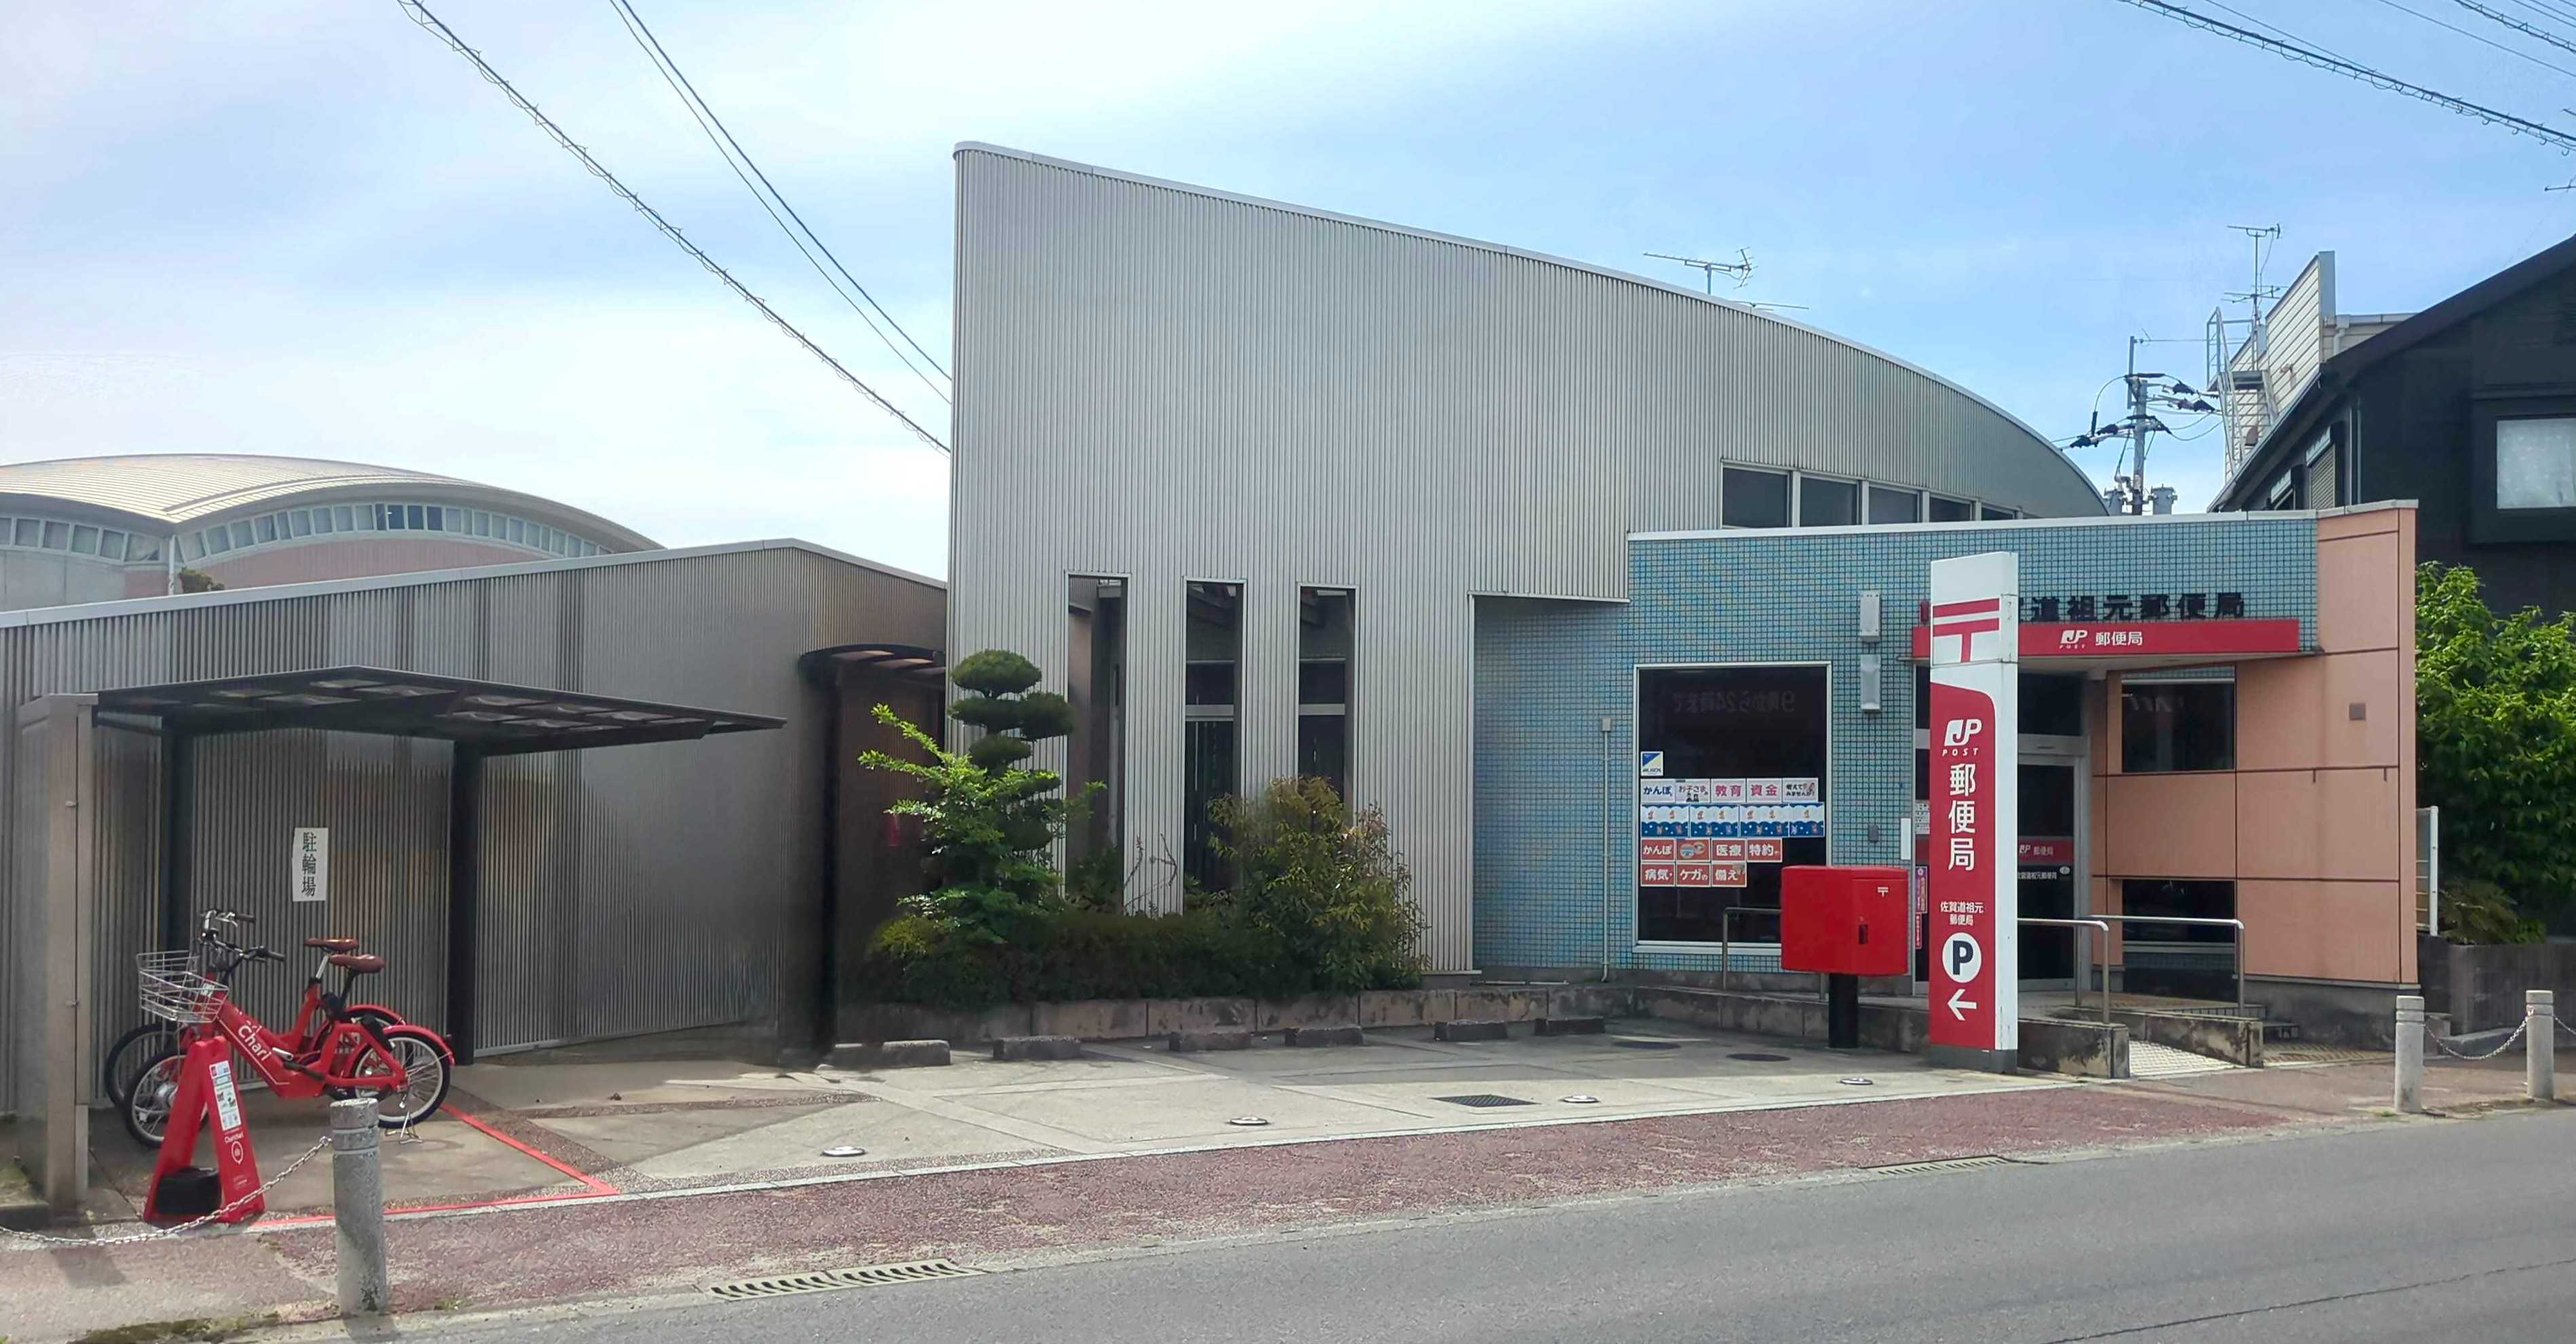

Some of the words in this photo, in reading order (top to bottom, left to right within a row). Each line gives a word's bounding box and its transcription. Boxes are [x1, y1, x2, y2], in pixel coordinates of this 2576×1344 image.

[2019, 592, 2244, 622] 道祖元郵便局
[2061, 629, 2088, 644] JP
[2095, 631, 2143, 646] 郵便局
[1944, 719, 1982, 747] JP
[1942, 748, 1979, 757] POST
[1716, 785, 1741, 797] 教育
[1751, 785, 1777, 796] 資金
[1948, 763, 1976, 871] 郵便局
[1643, 845, 1671, 855] かんぽ
[1716, 845, 1741, 856] 医療
[302, 831, 317, 896] 駐輪場
[1940, 901, 1984, 913] 佐賀道祖元
[1949, 913, 1974, 926] 郵便局
[1952, 940, 1974, 975] P
[238, 1025, 272, 1061] Chari
